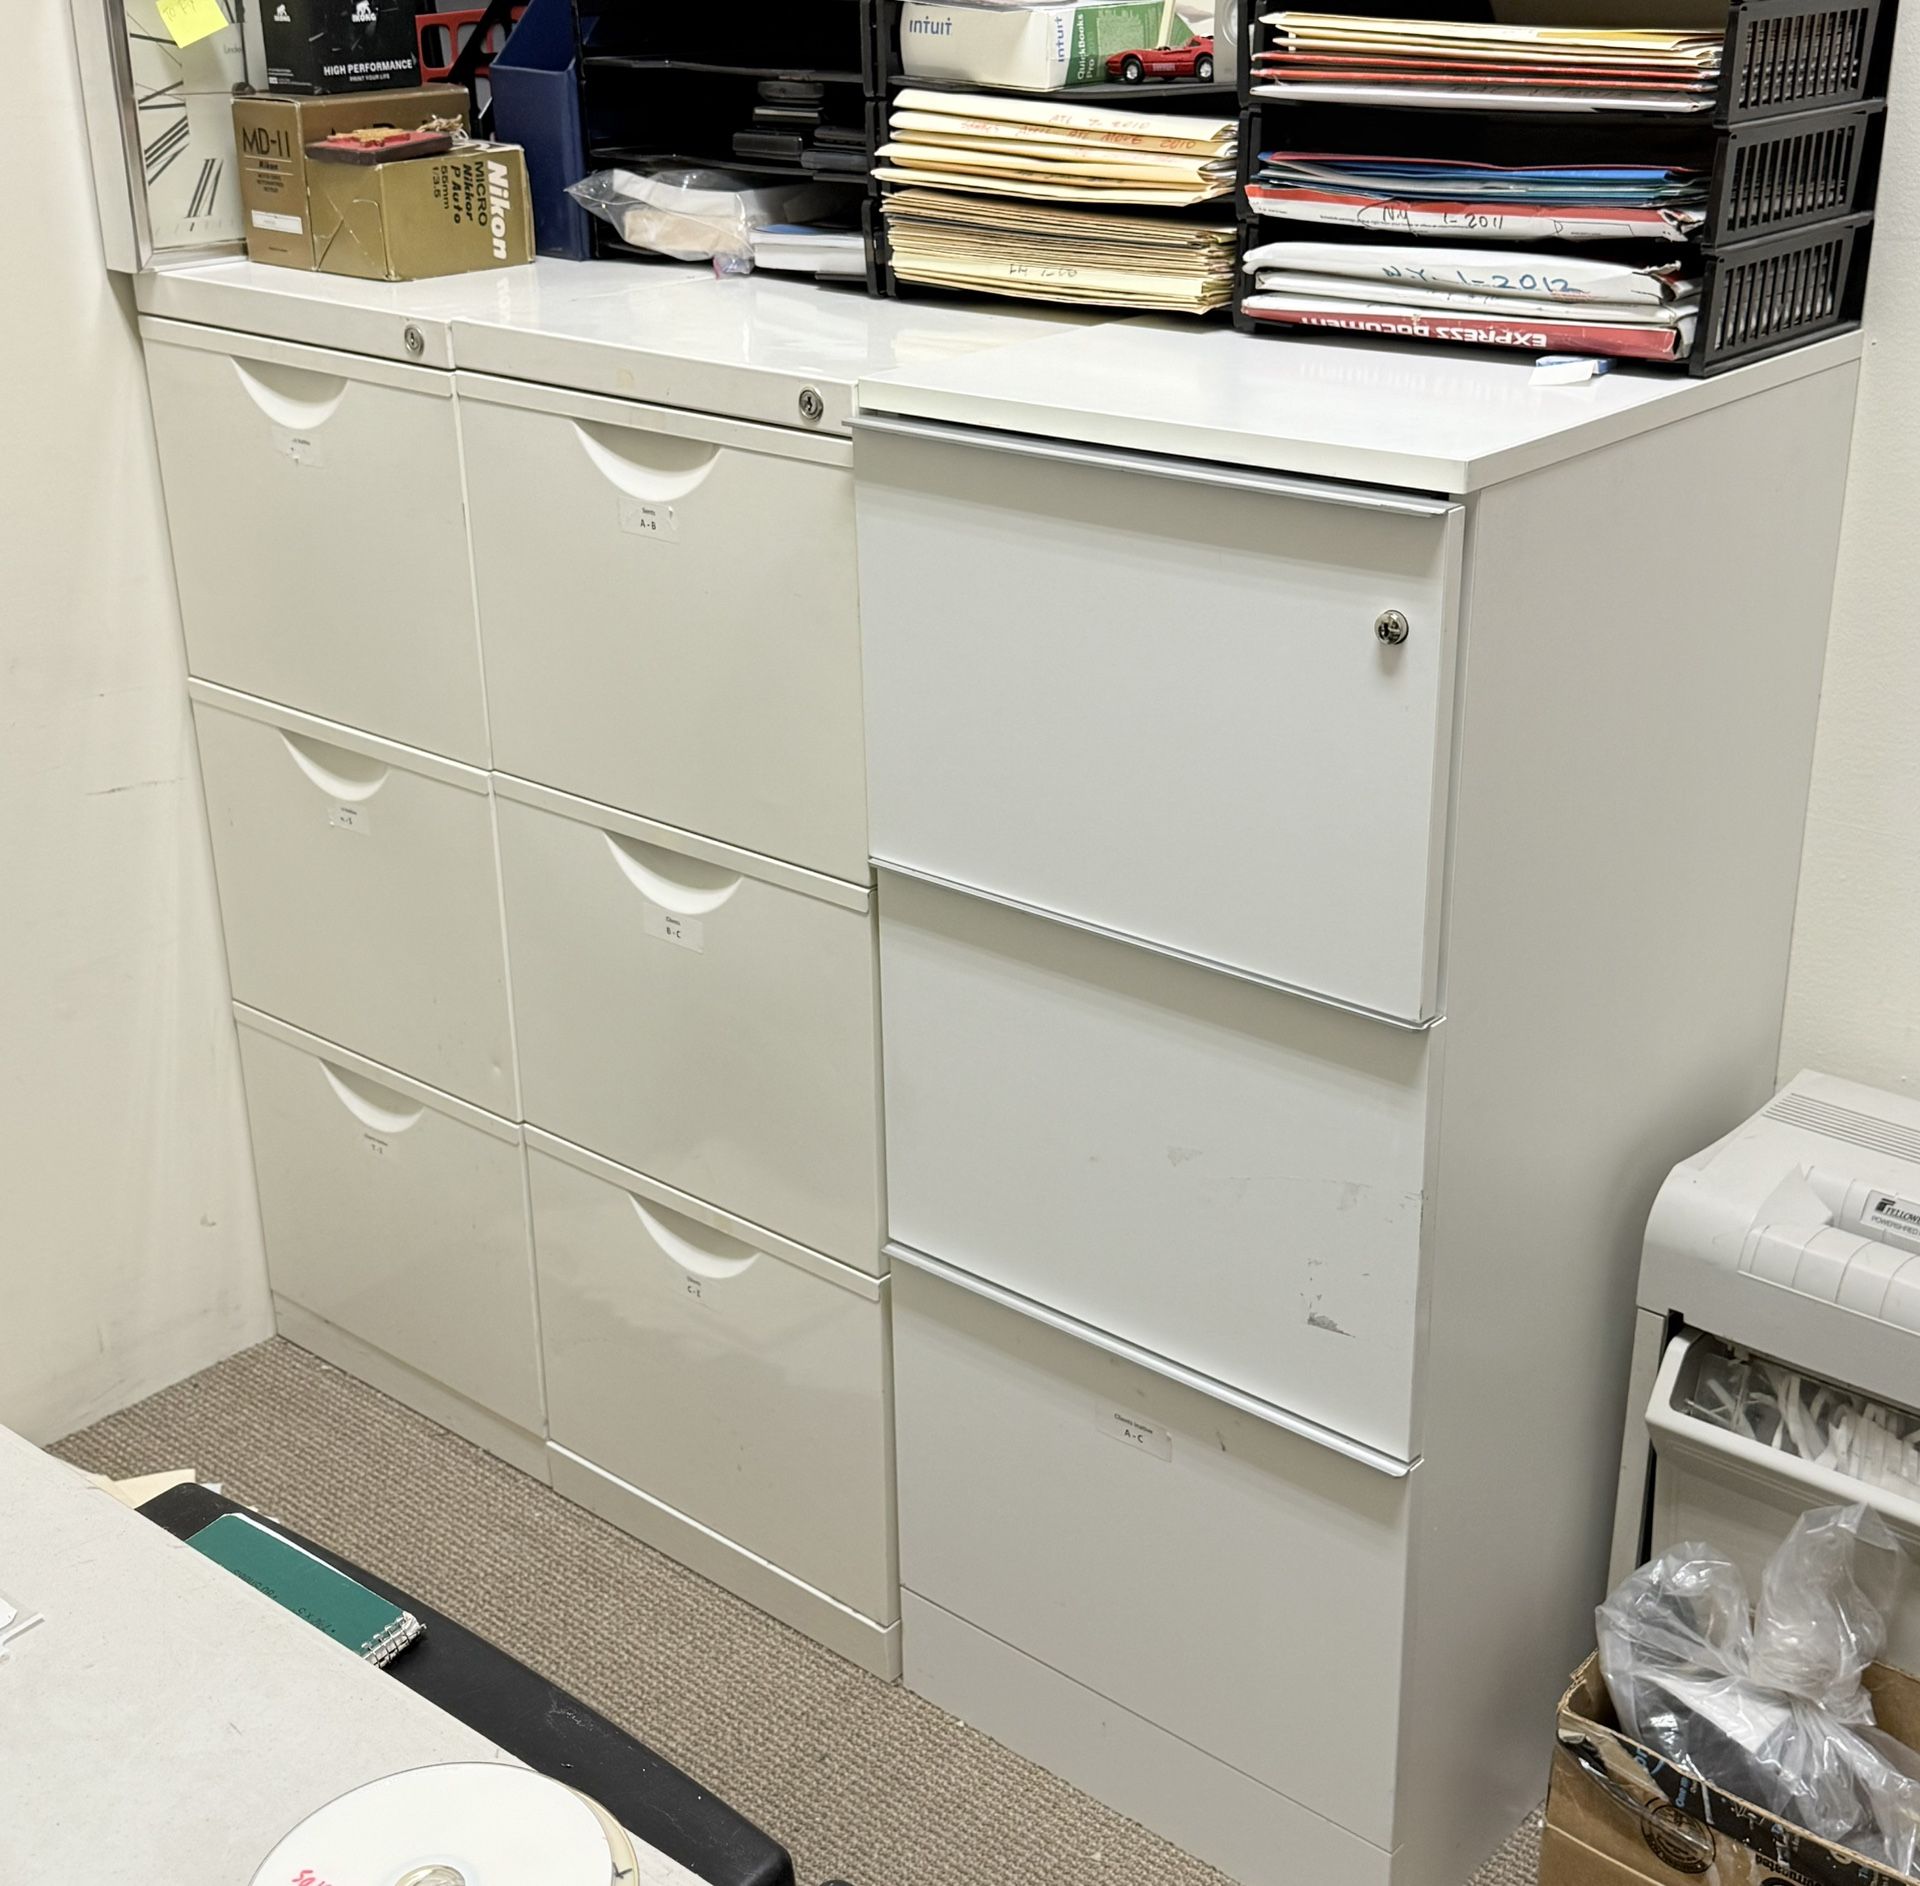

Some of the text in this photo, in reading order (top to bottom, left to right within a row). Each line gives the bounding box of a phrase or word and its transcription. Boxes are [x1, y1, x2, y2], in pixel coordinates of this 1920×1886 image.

[909, 15, 952, 36] intuit
[1055, 16, 1065, 63] intuit
[1077, 13, 1086, 80] QuickBooks
[323, 58, 413, 76] HIGH PERFORMANCE
[1086, 59, 1095, 78] Pro
[450, 164, 463, 225] P Auto
[463, 163, 475, 222] Nikkor
[474, 161, 488, 227] MICRO
[487, 159, 511, 260] Nikon
[1437, 326, 1547, 348] EXPRESS
